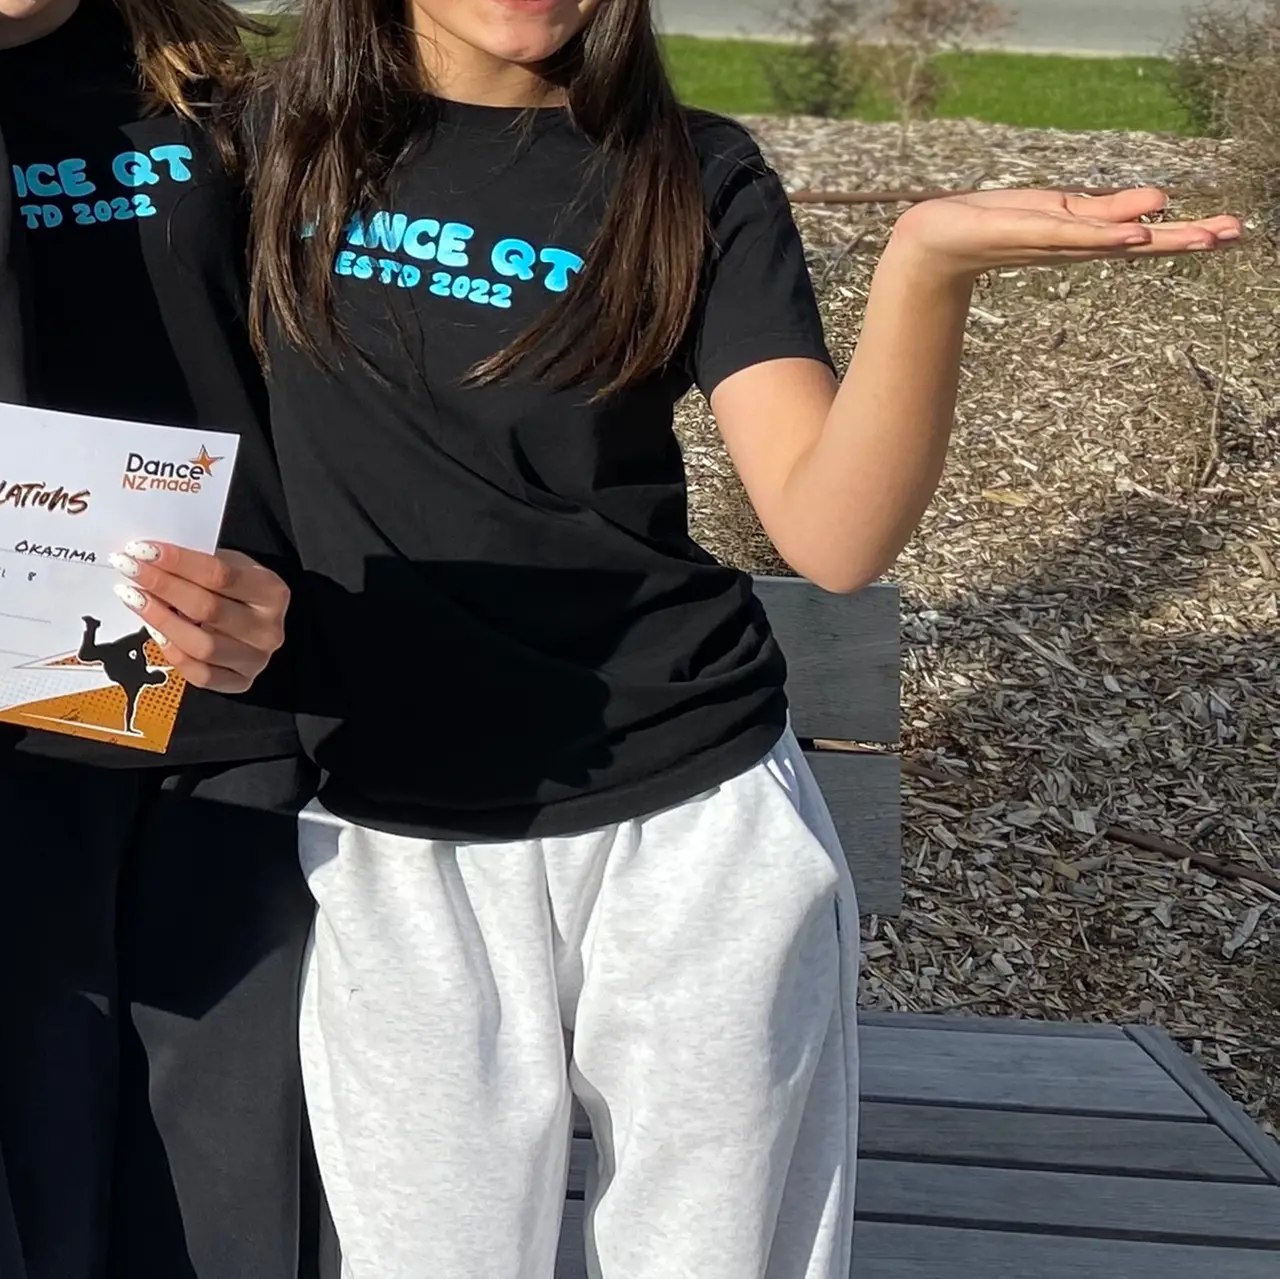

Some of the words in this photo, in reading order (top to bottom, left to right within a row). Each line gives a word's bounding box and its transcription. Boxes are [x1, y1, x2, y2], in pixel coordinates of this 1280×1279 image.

[111, 144, 193, 188] QT
[71, 193, 157, 226] 2022
[333, 250, 421, 288] ESTD
[428, 271, 513, 309] 2022
[490, 237, 586, 293] QT
[125, 452, 204, 480] Dance
[121, 473, 149, 492] NZ
[149, 476, 202, 494] made
[14, 539, 97, 563] OKAJIMA
